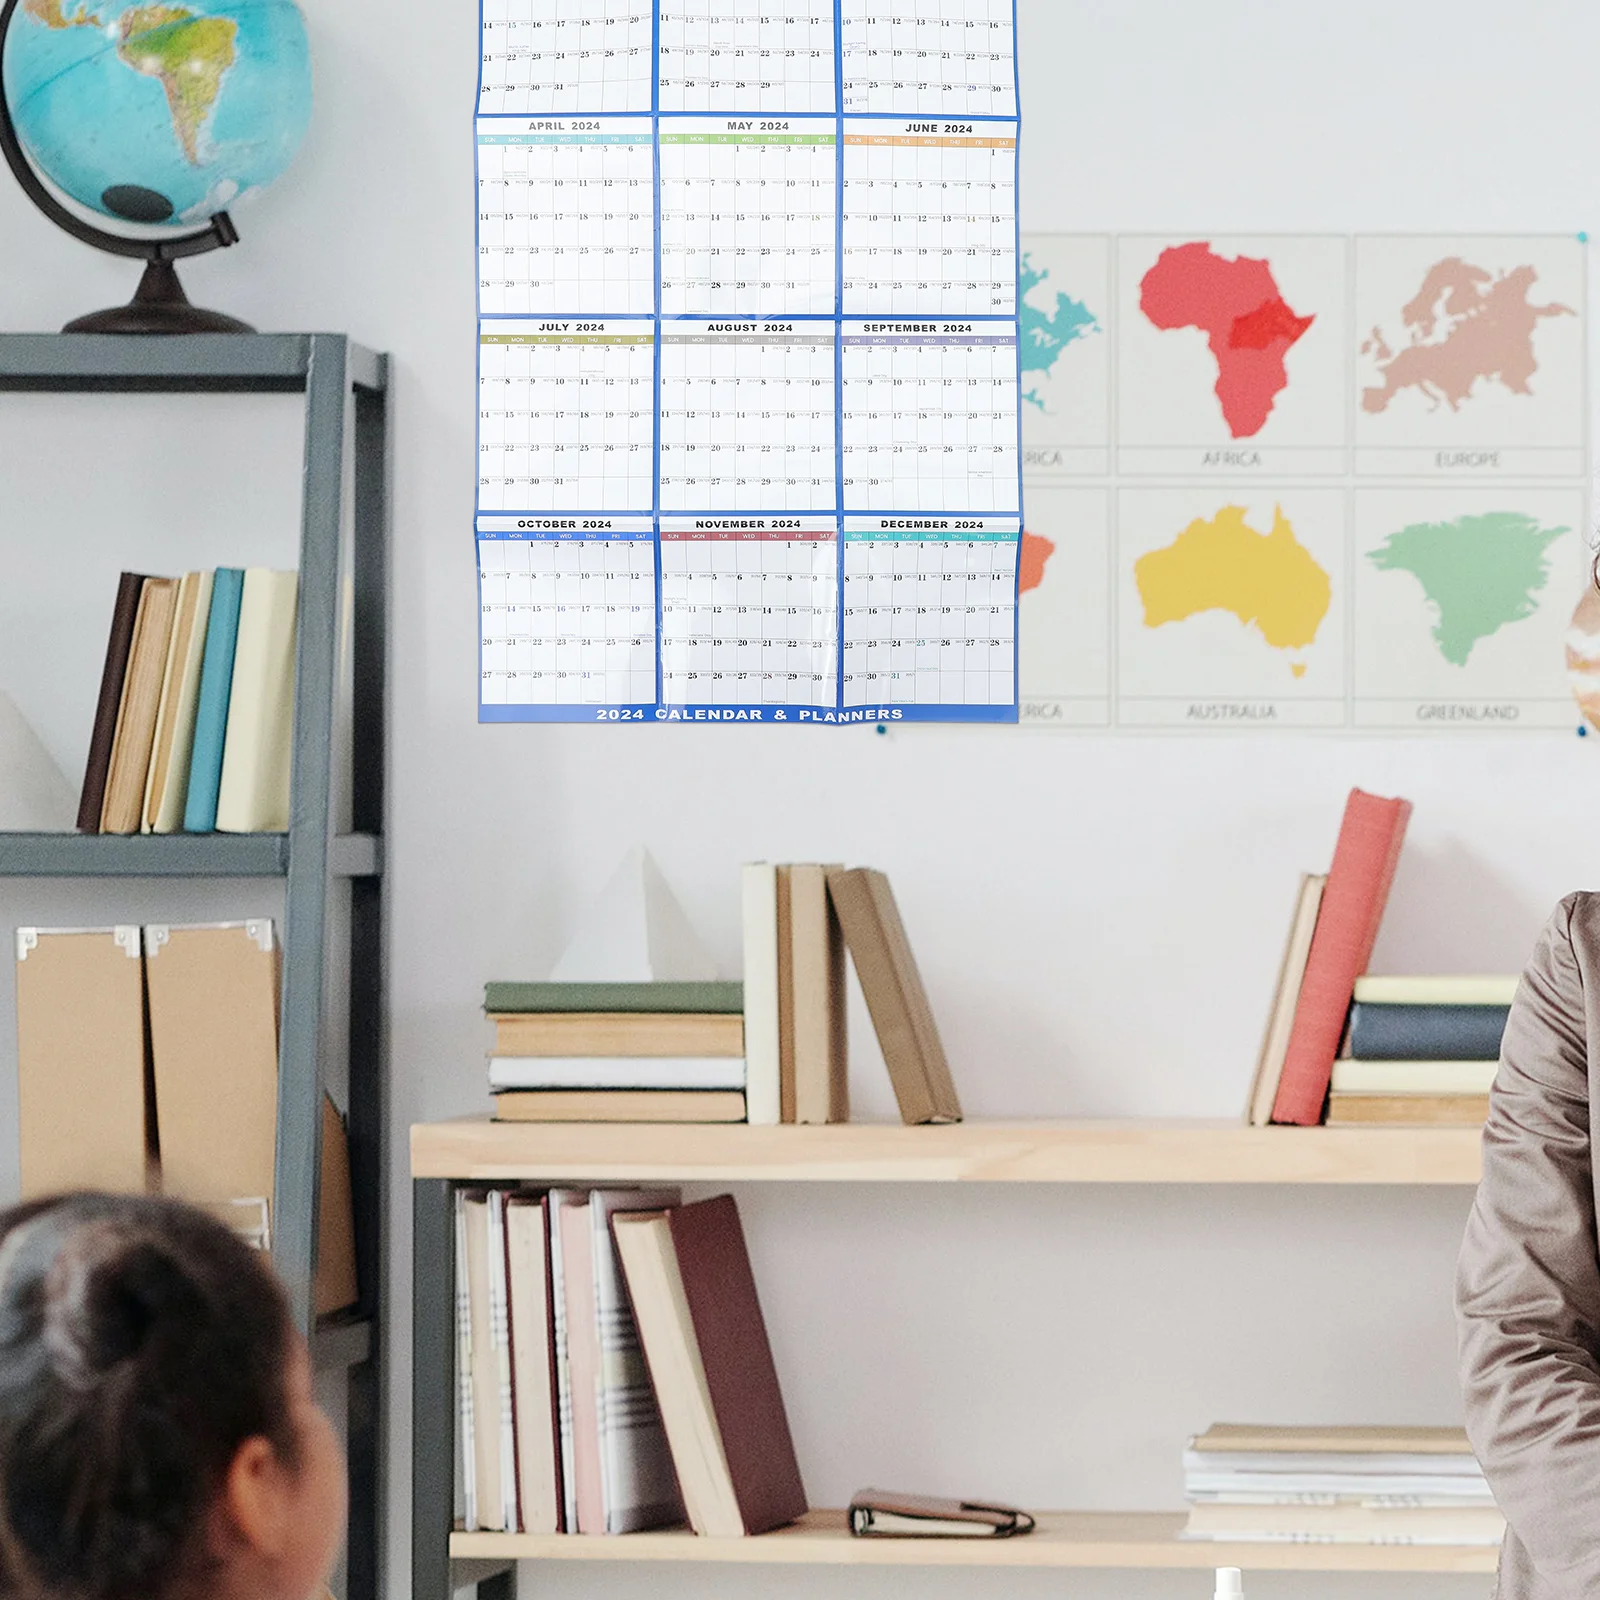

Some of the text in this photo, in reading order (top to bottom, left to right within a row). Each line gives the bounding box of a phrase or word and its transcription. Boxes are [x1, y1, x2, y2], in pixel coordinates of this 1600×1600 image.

[906, 124, 972, 133] JUNE 2024
[1201, 450, 1262, 467] AFRICA
[1435, 451, 1500, 468] EUROPE
[596, 709, 903, 723] 2024 CALENDAR & PLANNERS
[1186, 703, 1277, 720] AUSTRALIA
[1416, 703, 1520, 720] GREENLAND
